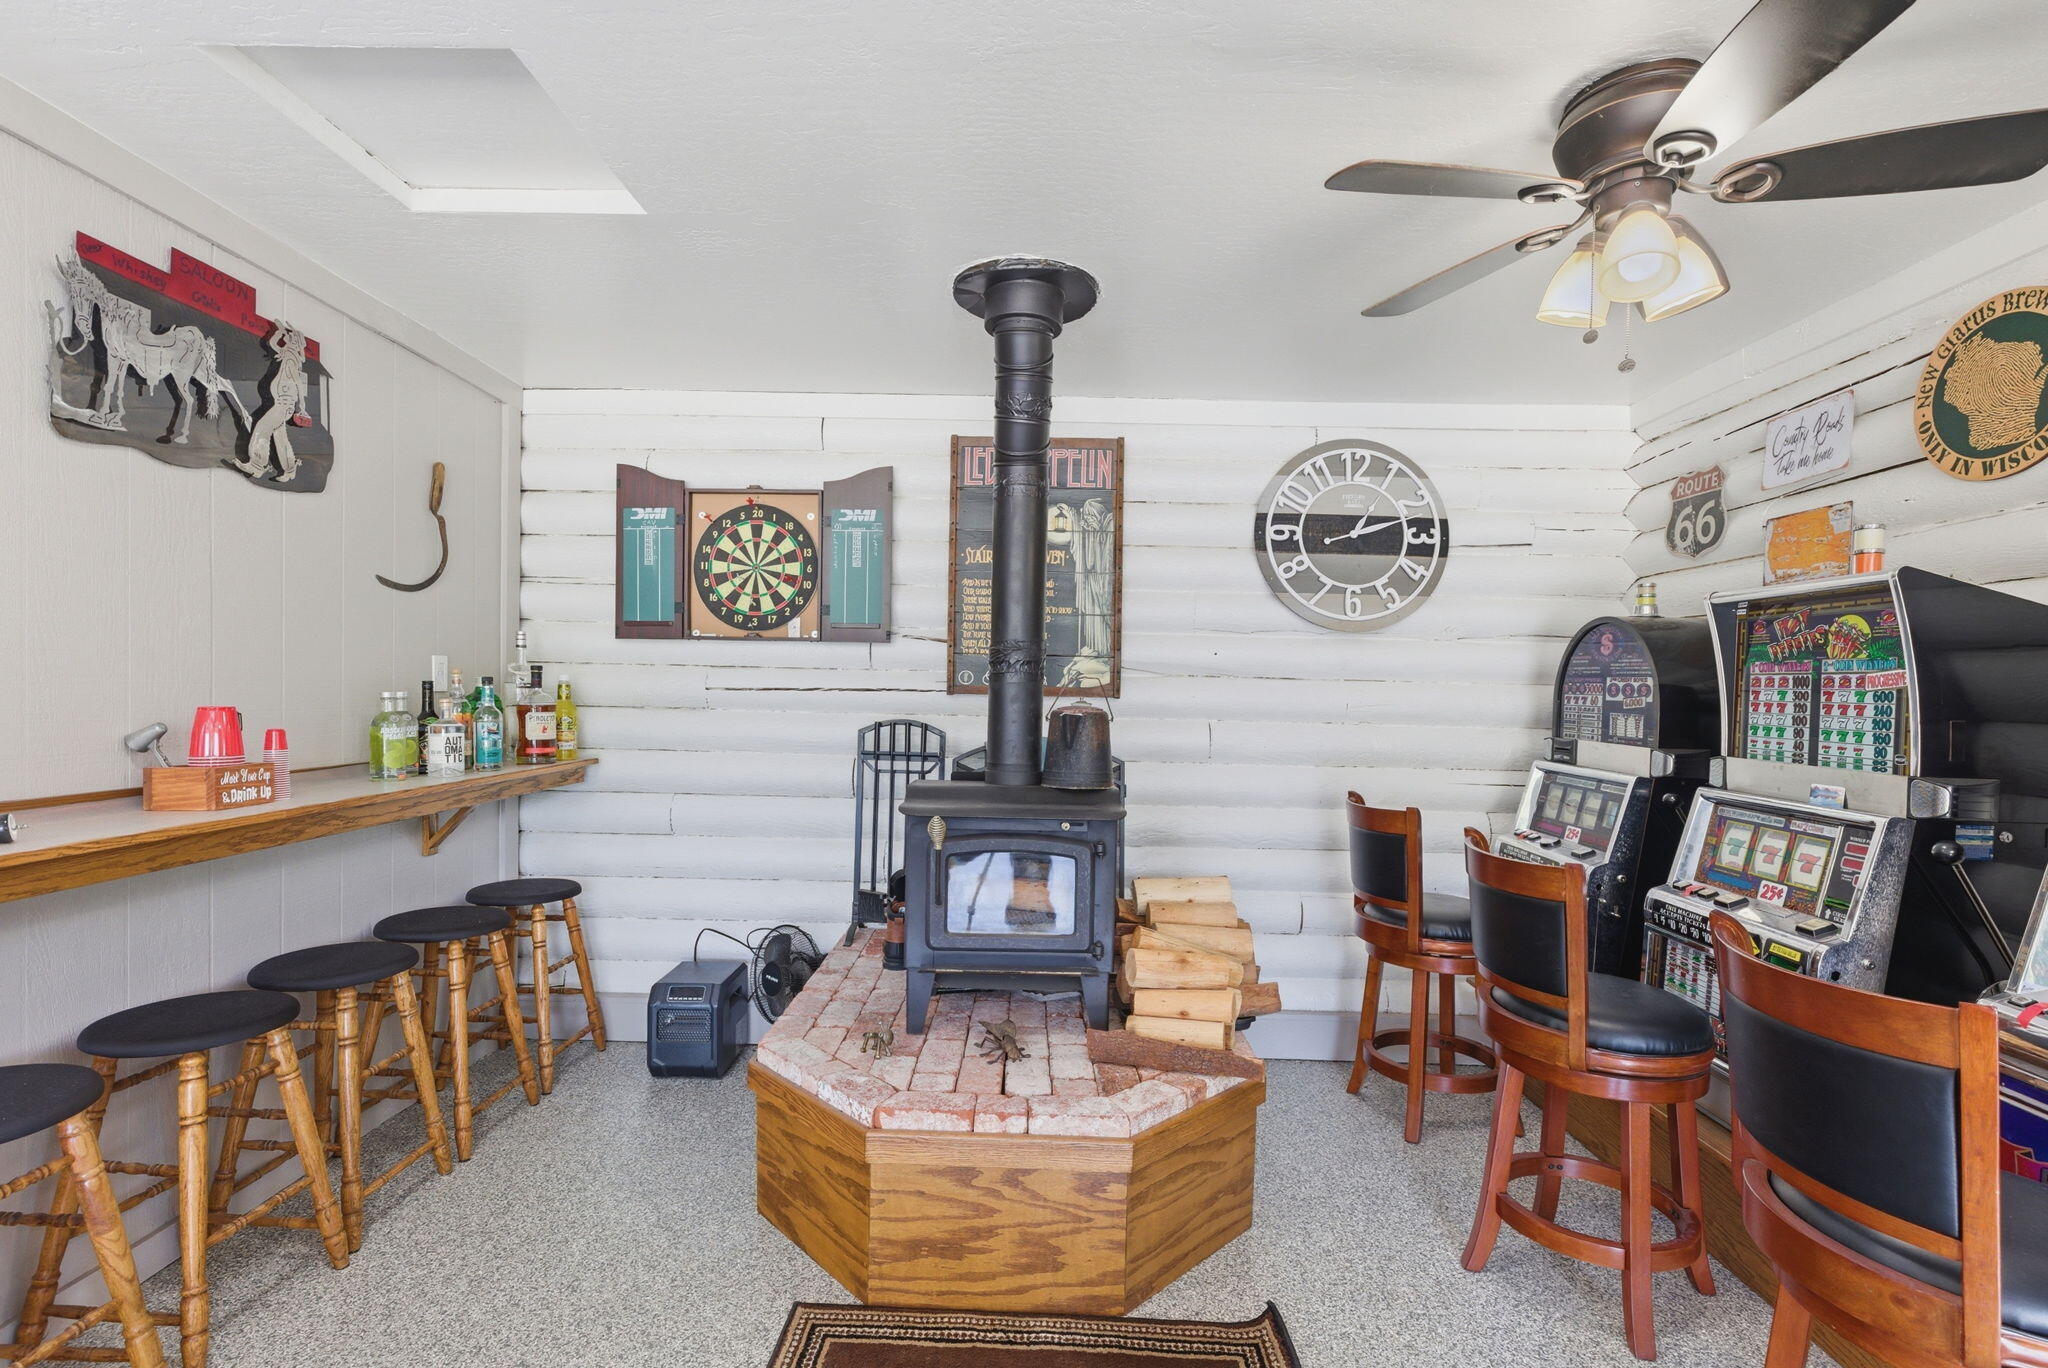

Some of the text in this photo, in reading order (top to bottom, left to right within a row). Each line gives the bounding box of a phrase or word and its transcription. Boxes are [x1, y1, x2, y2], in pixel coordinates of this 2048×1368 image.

[111, 253, 166, 292] Whiskey
[180, 257, 248, 299] SALOON
[1917, 365, 1940, 410] New
[1937, 301, 1996, 360] Glarus
[1772, 406, 1845, 458] Country Roads
[1918, 420, 1951, 465] ONLY
[1950, 457, 1974, 476] IN
[1341, 451, 1372, 483] 12
[1773, 450, 1795, 476] Take
[1798, 455, 1810, 469] me
[1304, 458, 1335, 492] 11
[1381, 462, 1400, 490] 1
[1677, 472, 1720, 497] ROUTE
[1278, 483, 1314, 513] 10
[1396, 490, 1430, 515] 2
[740, 512, 746, 520] 5
[752, 510, 764, 518] 20
[772, 514, 777, 522] 1
[723, 520, 732, 528] 12
[785, 522, 794, 530] 18
[1675, 500, 1716, 547] 66
[713, 531, 719, 539] 9
[798, 534, 804, 542] 4
[1270, 524, 1300, 541] 9
[1407, 527, 1438, 545] 3
[703, 546, 711, 554] 14
[804, 549, 812, 557] 13
[701, 562, 708, 570] 11
[807, 565, 813, 573] 6
[1278, 555, 1310, 580] 8
[1401, 557, 1430, 582] 4
[704, 579, 710, 587] 8
[1308, 576, 1334, 606] 7
[1375, 577, 1400, 610] 5
[710, 594, 718, 602] 16
[795, 597, 804, 605] 15
[1345, 586, 1362, 618] 6
[784, 608, 791, 616] 2
[735, 615, 743, 623] 19
[752, 617, 758, 626] 3
[768, 616, 777, 624] 17
[1792, 676, 1810, 689] 1000
[1792, 691, 1809, 702] 300
[1873, 691, 1895, 703] 600
[1793, 703, 1808, 714] 120
[1874, 705, 1893, 718] 240
[1792, 716, 1808, 727] 100
[1872, 719, 1893, 731] 200
[1793, 728, 1805, 739] 80
[1872, 733, 1891, 746] 160
[445, 736, 463, 746] AUT
[445, 755, 463, 763] TIC
[1874, 747, 1888, 759] 80
[222, 792, 231, 803] &
[1760, 884, 1784, 901] 25¢
